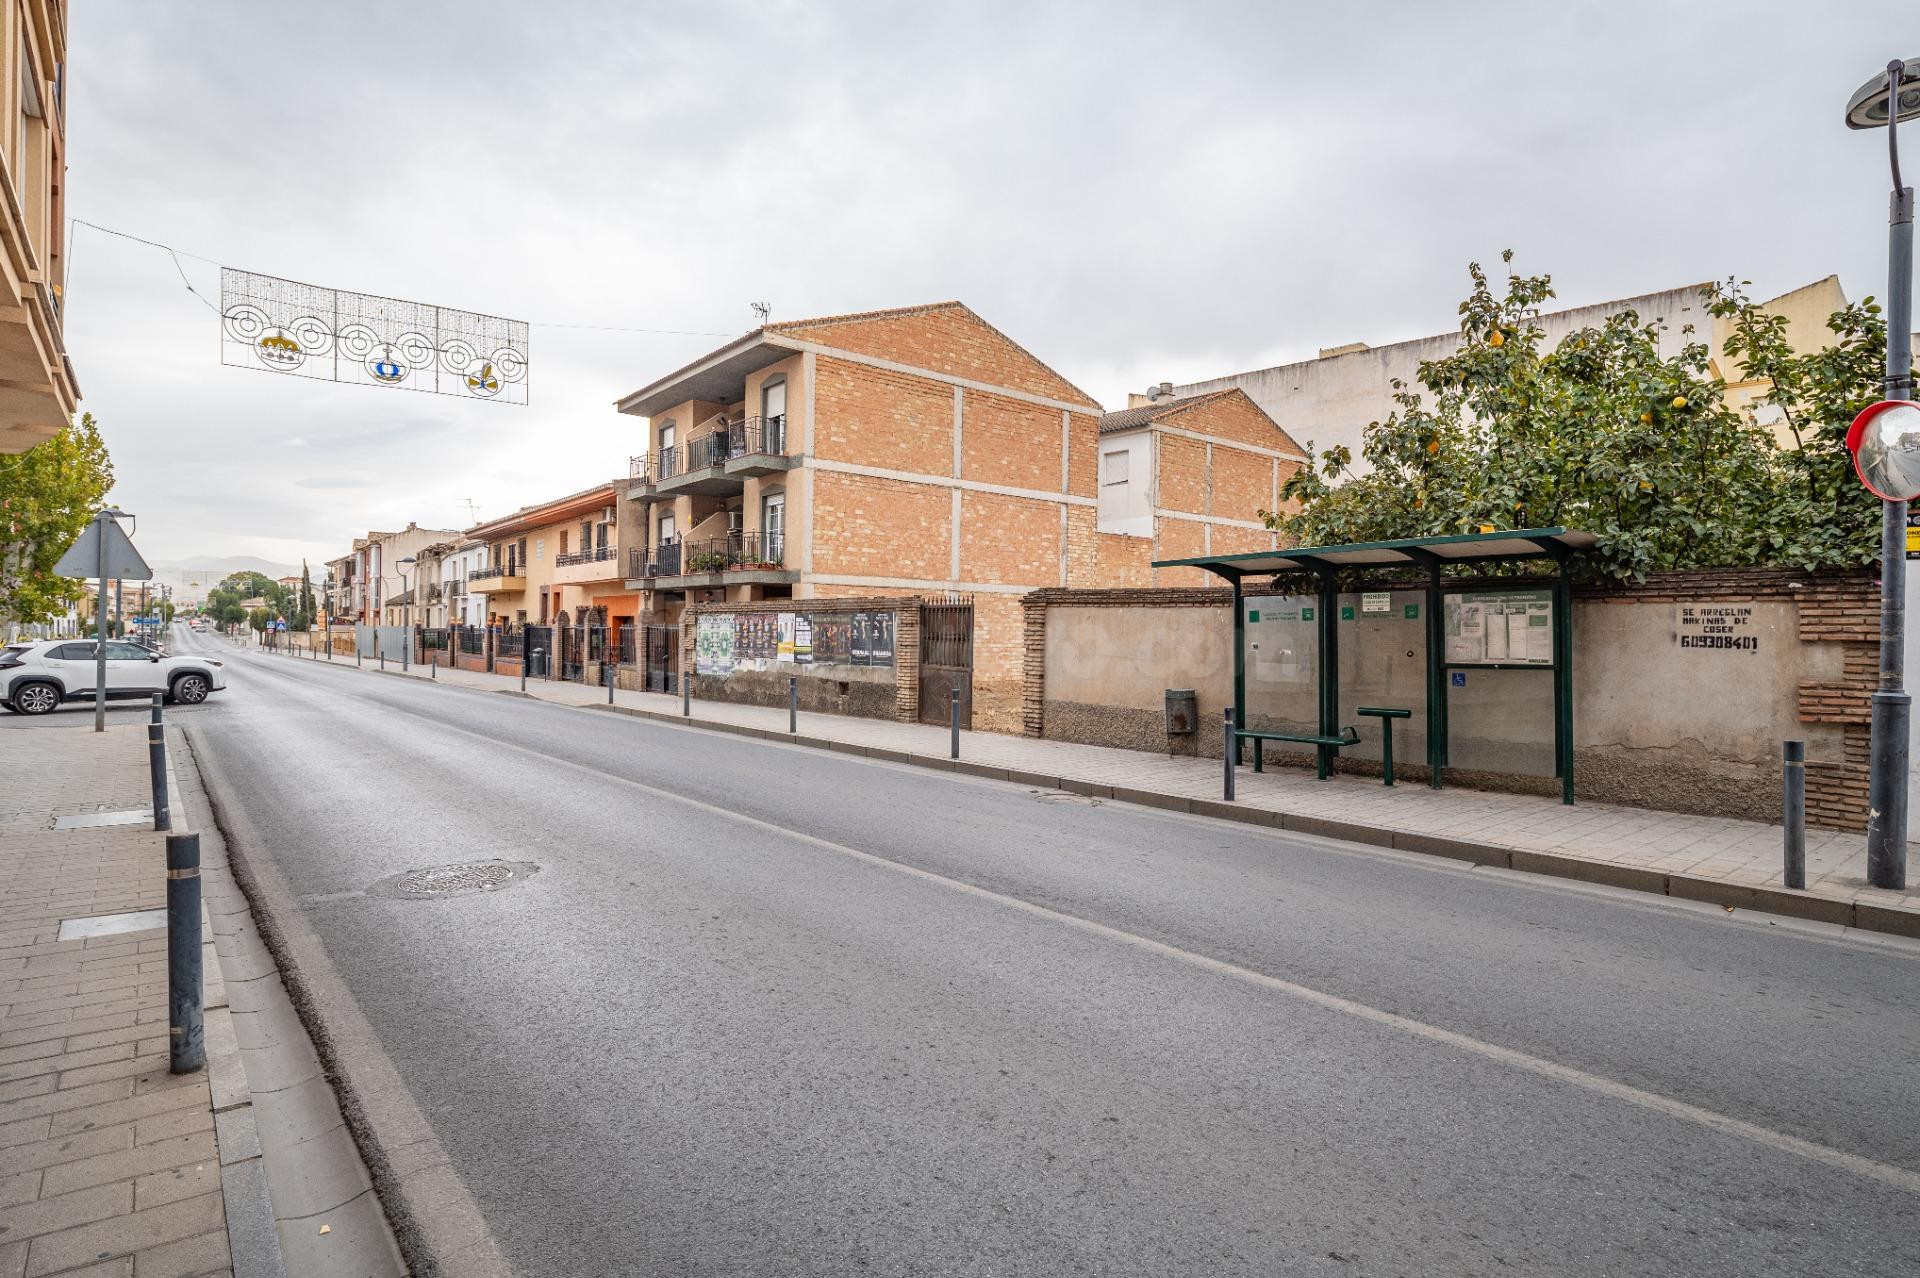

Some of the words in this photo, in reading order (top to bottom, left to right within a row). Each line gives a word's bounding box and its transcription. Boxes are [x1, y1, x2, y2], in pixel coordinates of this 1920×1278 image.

[1683, 608, 1694, 616] SE
[1701, 608, 1752, 616] ARREGLAN
[1683, 617, 1726, 625] MAKINAS
[1734, 617, 1748, 625] DE
[1681, 636, 1758, 649] 609308401
